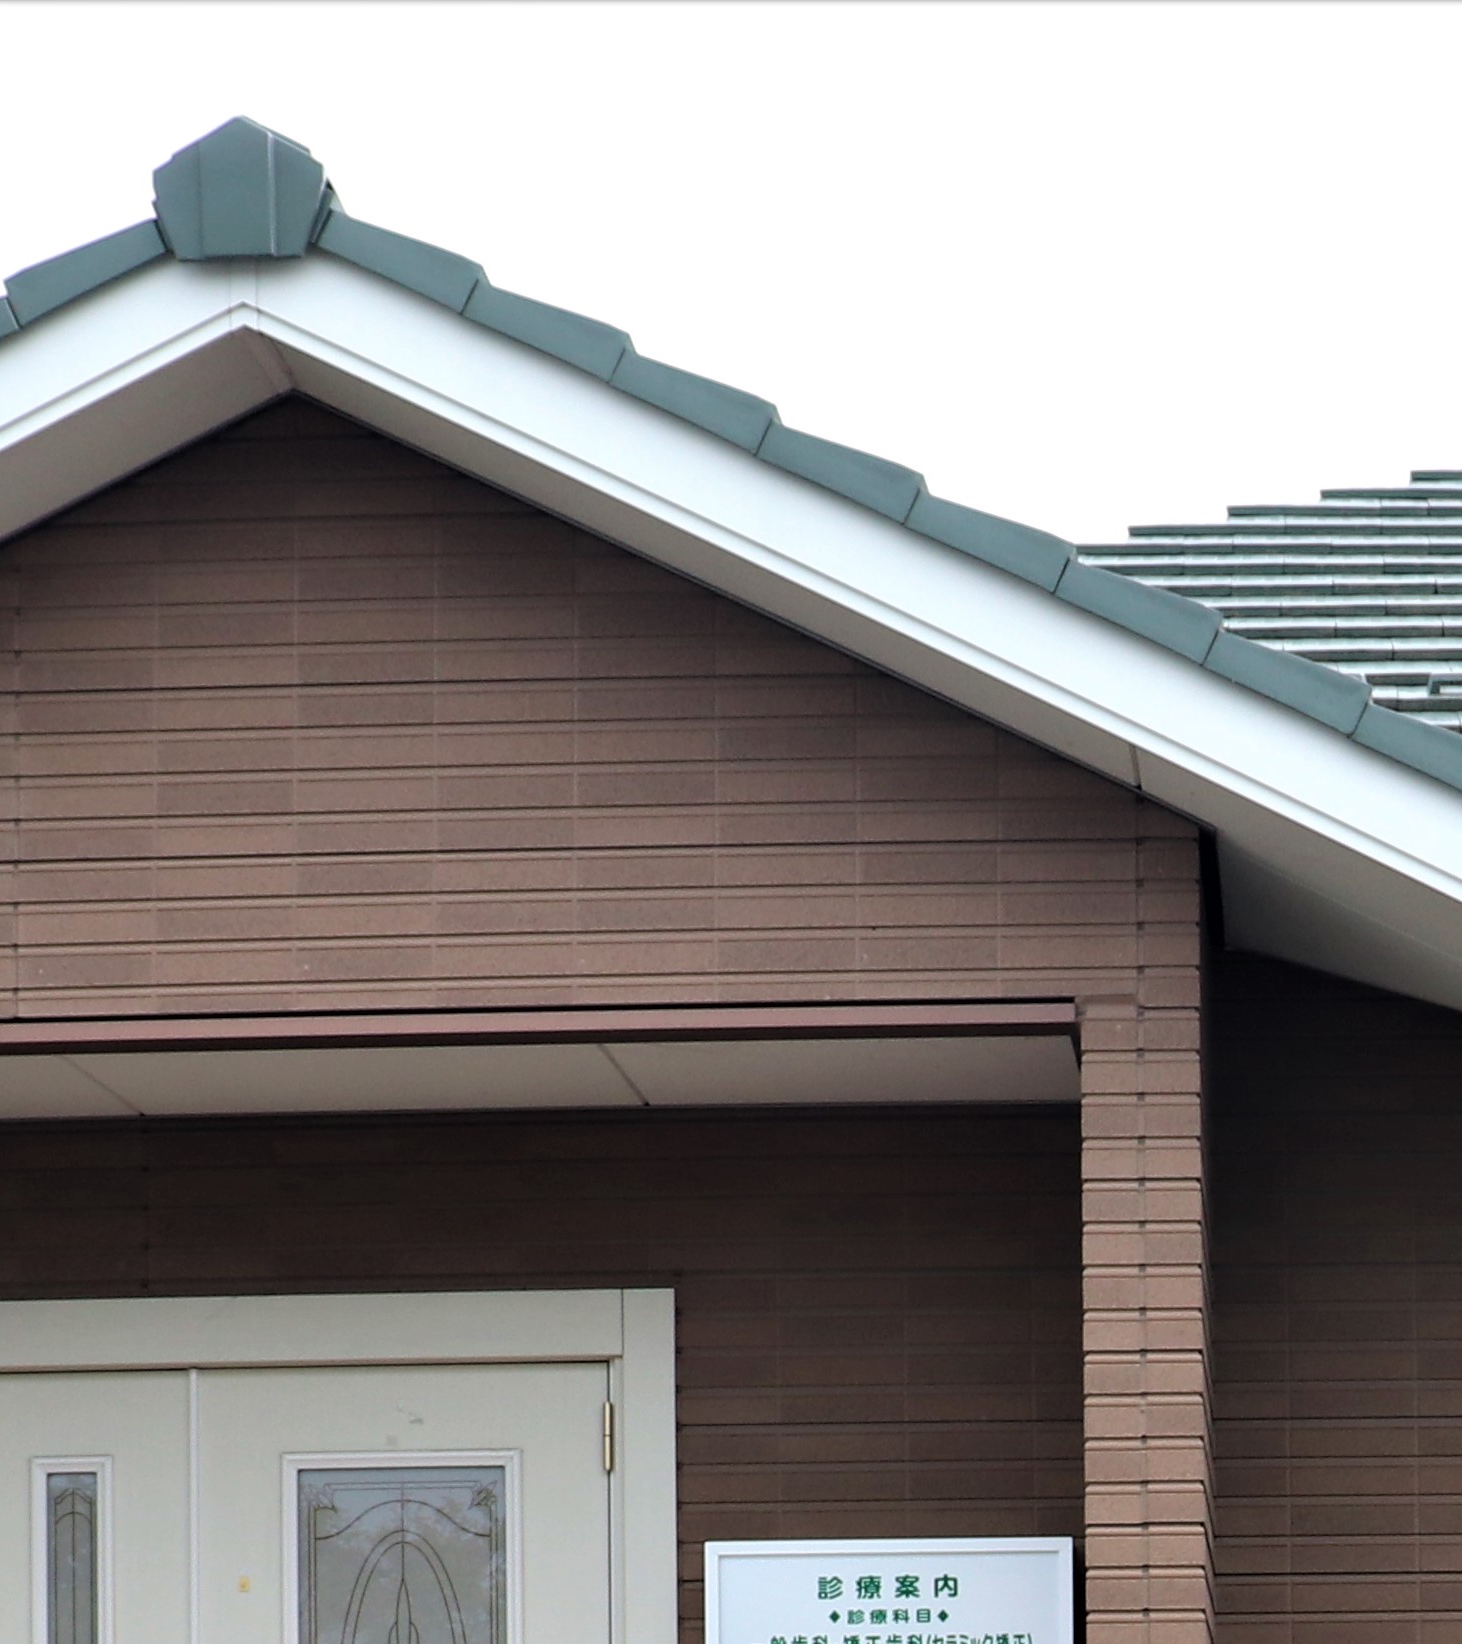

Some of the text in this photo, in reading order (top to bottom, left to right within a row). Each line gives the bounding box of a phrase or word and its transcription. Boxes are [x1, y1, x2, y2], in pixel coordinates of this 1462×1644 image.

[818, 1574, 958, 1600] 診療案内
[847, 1609, 931, 1625] 診療科目
